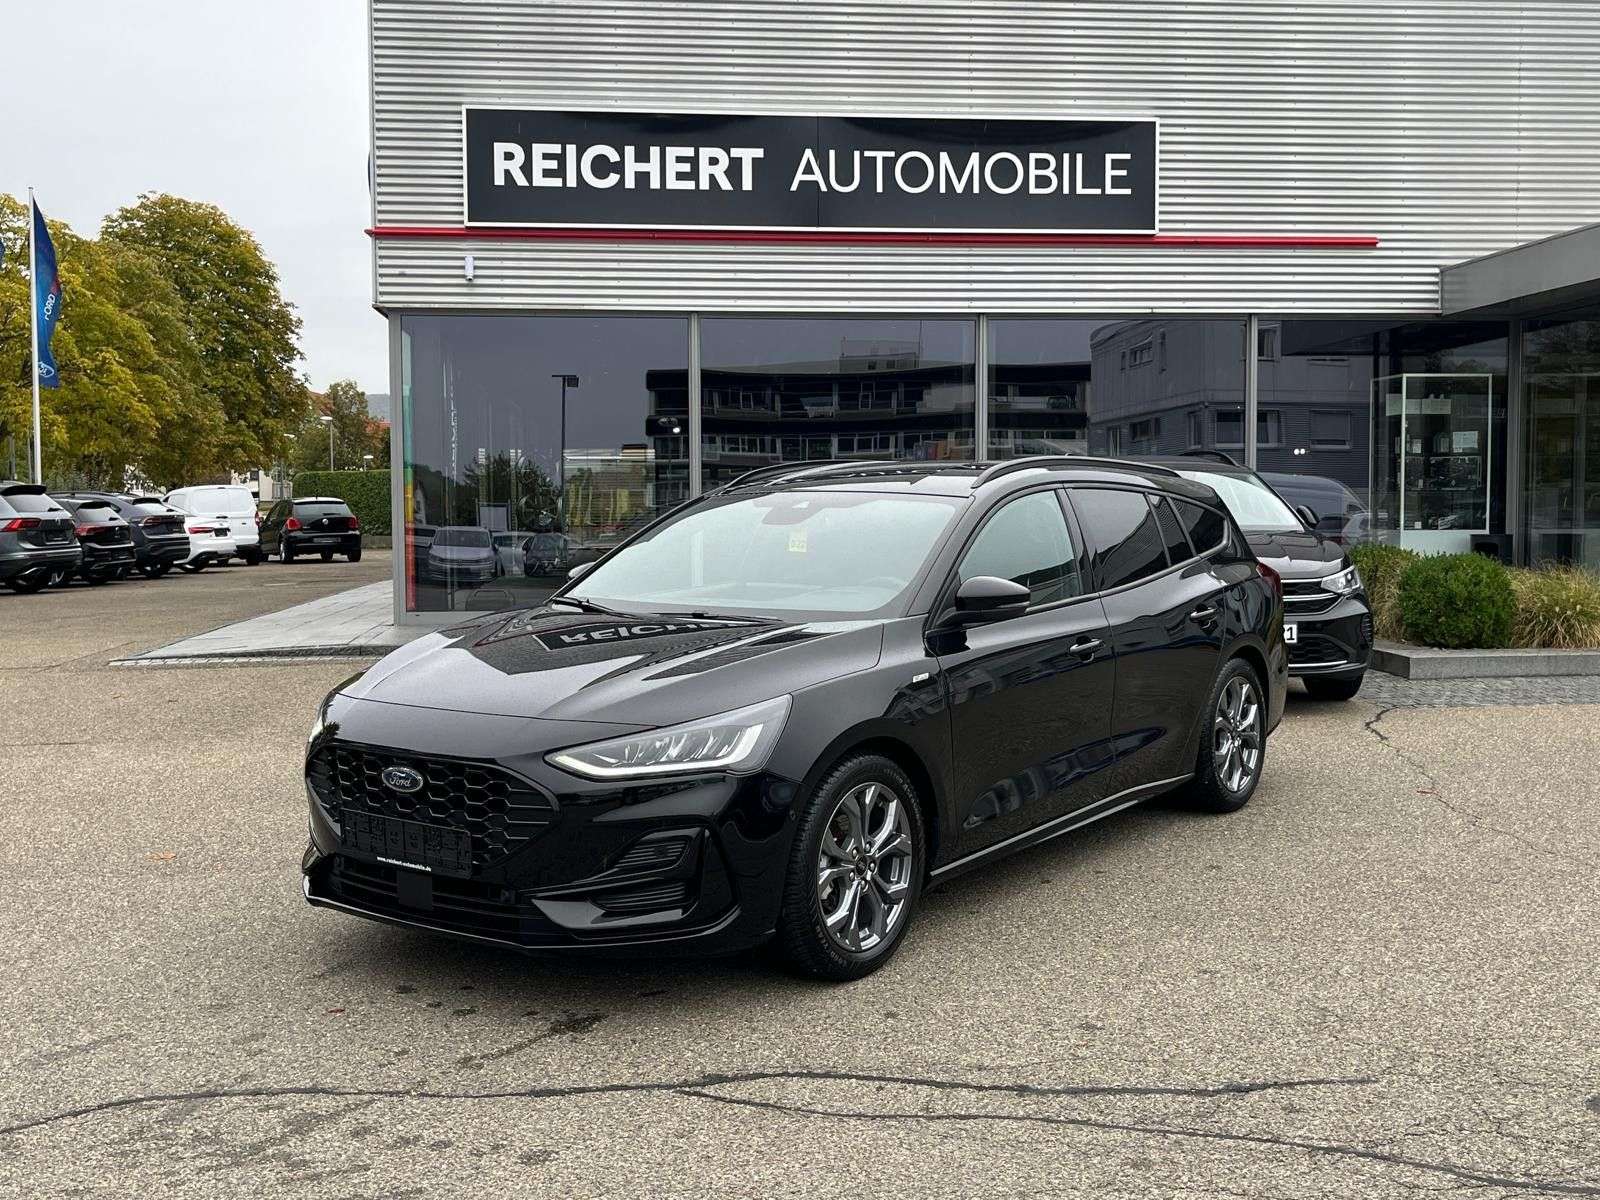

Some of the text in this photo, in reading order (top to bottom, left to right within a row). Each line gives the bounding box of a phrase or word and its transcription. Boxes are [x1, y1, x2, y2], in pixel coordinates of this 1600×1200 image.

[492, 142, 1132, 195] REICHERT AUTOMOBILE
[389, 771, 411, 787] Ford
